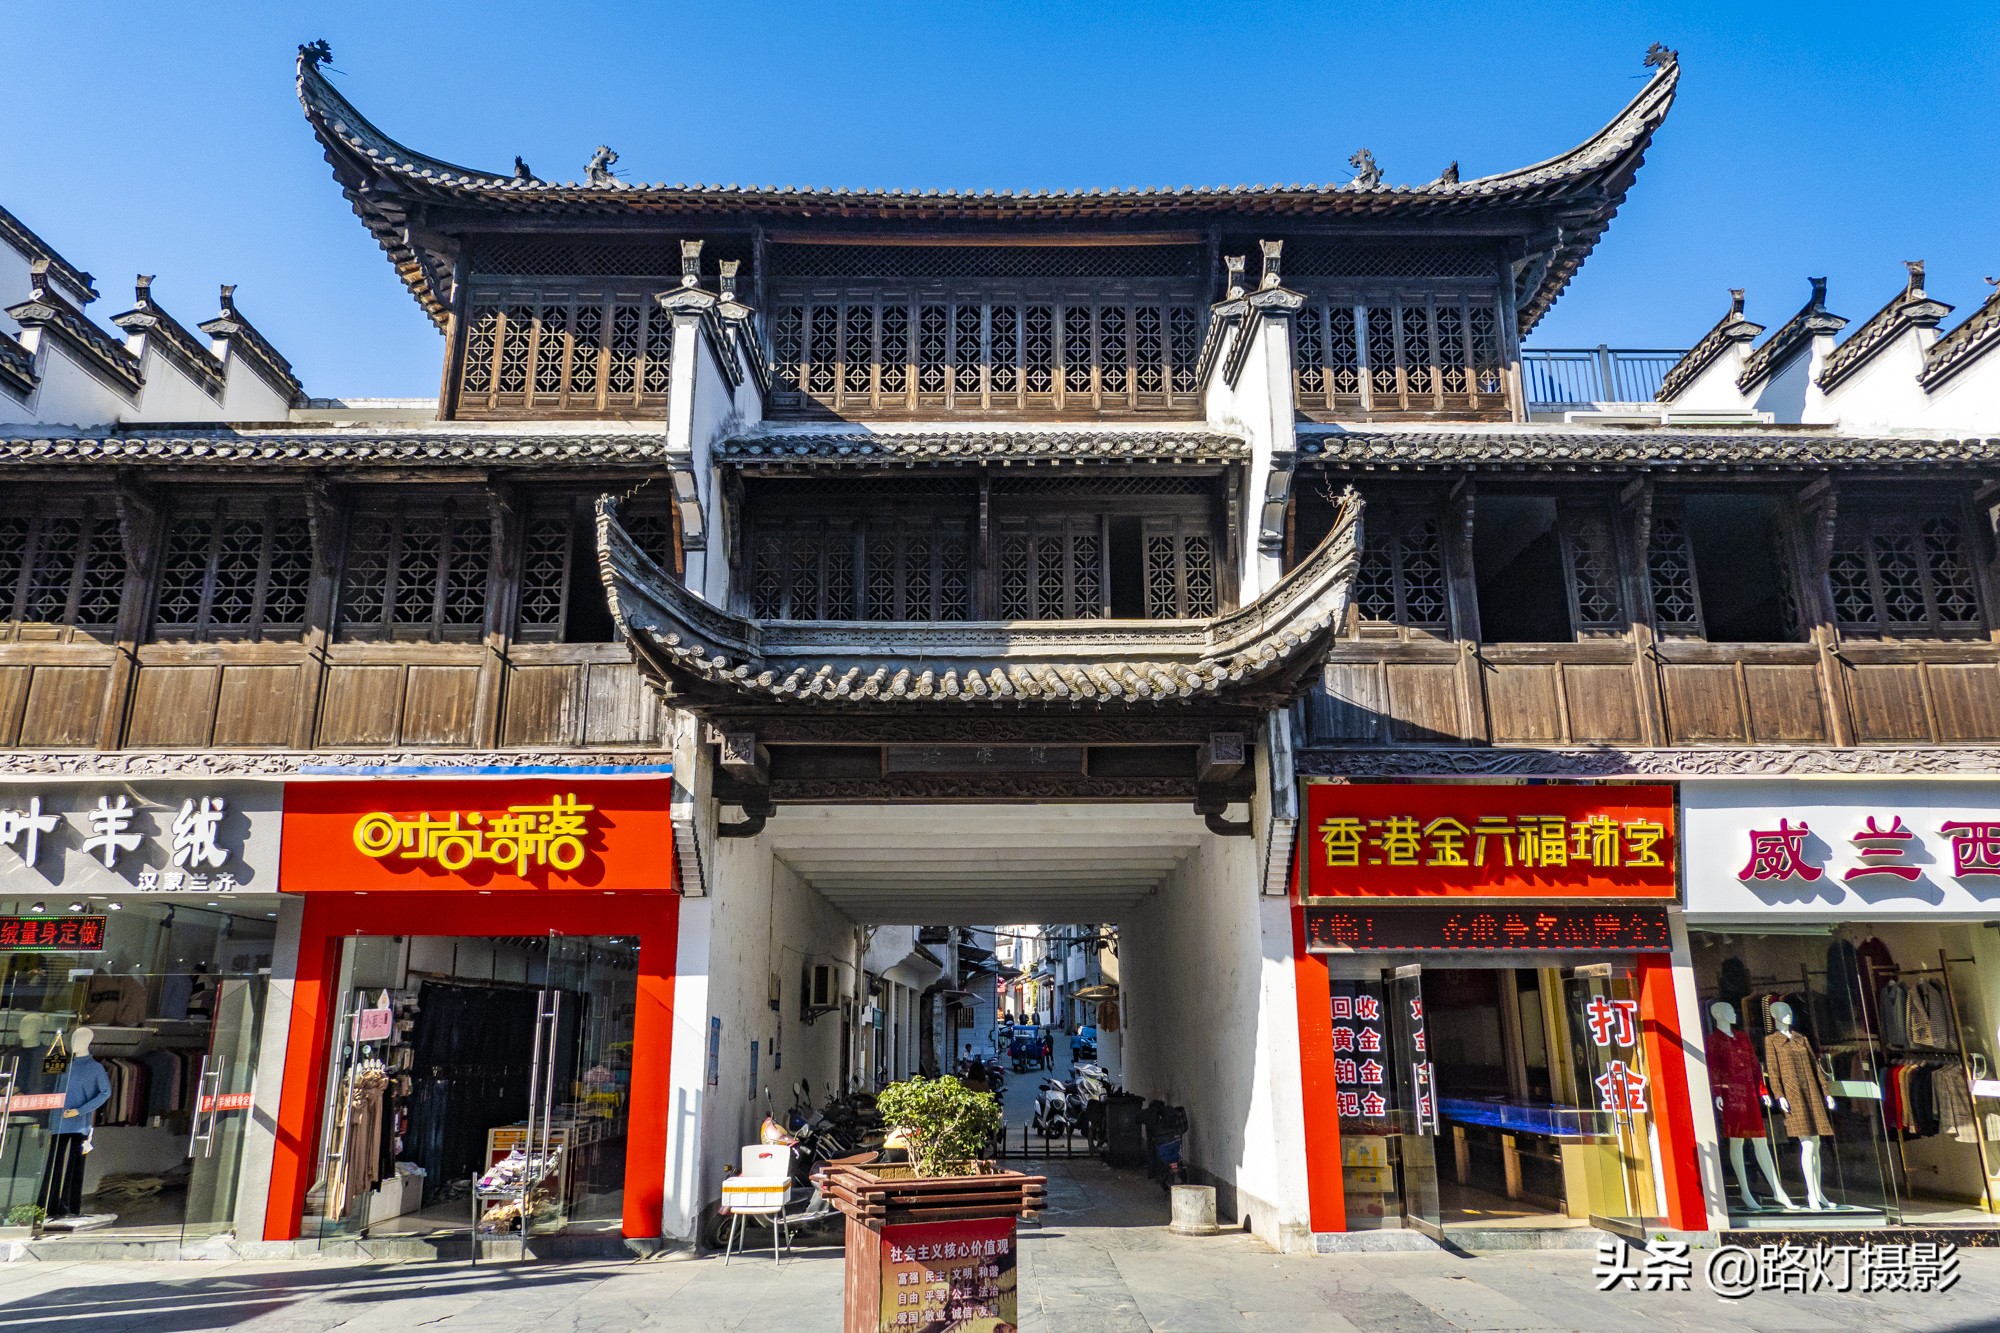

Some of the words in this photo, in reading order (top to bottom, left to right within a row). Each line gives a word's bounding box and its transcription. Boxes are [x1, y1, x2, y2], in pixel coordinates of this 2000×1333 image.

[0, 796, 229, 868] 叶羊绒
[1318, 815, 1665, 867] 香港金六福珠宝
[1738, 815, 2000, 882] 威兰西
[138, 872, 236, 891] 汉蒙兰齐
[0, 920, 98, 945] 绒量身定做
[1330, 994, 1379, 1020] 回收
[1332, 1026, 1381, 1051] 黄金
[1587, 995, 1648, 1112] 打金
[1334, 1058, 1383, 1083] 铂金
[1336, 1090, 1385, 1116] 钯金
[890, 1239, 1009, 1263] 社会主义核心价值观
[898, 1272, 918, 1285] 富强
[925, 1270, 946, 1283] 民主
[952, 1268, 972, 1280] 文明
[978, 1265, 999, 1278] 和谐
[898, 1292, 918, 1305] 自由
[925, 1289, 947, 1303] 平等
[952, 1287, 972, 1299] 公正
[978, 1285, 999, 1297] 法治
[897, 1311, 919, 1324] 爱国
[924, 1309, 946, 1321] 敬业
[951, 1306, 973, 1319] 诚信
[979, 1304, 999, 1317] 友善
